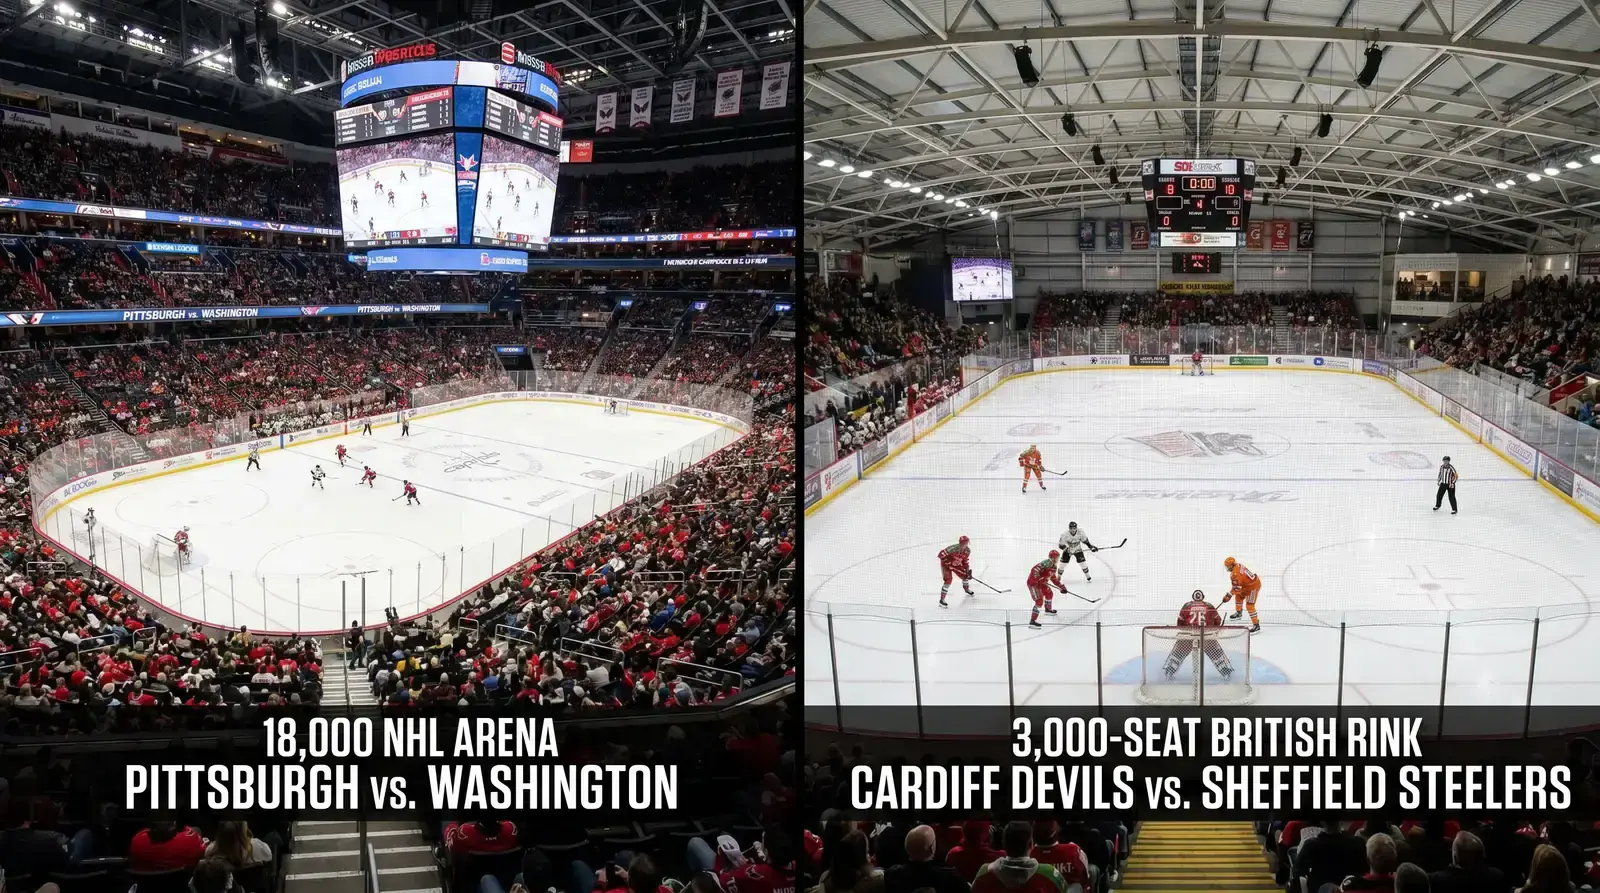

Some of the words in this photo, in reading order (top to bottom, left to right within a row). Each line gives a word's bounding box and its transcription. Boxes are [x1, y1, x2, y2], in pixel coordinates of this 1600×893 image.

[1190, 178, 1214, 189] 0:00
[1225, 184, 1235, 195] 10
[1163, 216, 1170, 226] 0
[1232, 216, 1238, 226] 0
[357, 305, 394, 314] PITTSBURGH
[402, 304, 442, 312] WASHINGTON
[123, 309, 186, 321] PITTSBURGH
[201, 308, 259, 319] WASHINGTON
